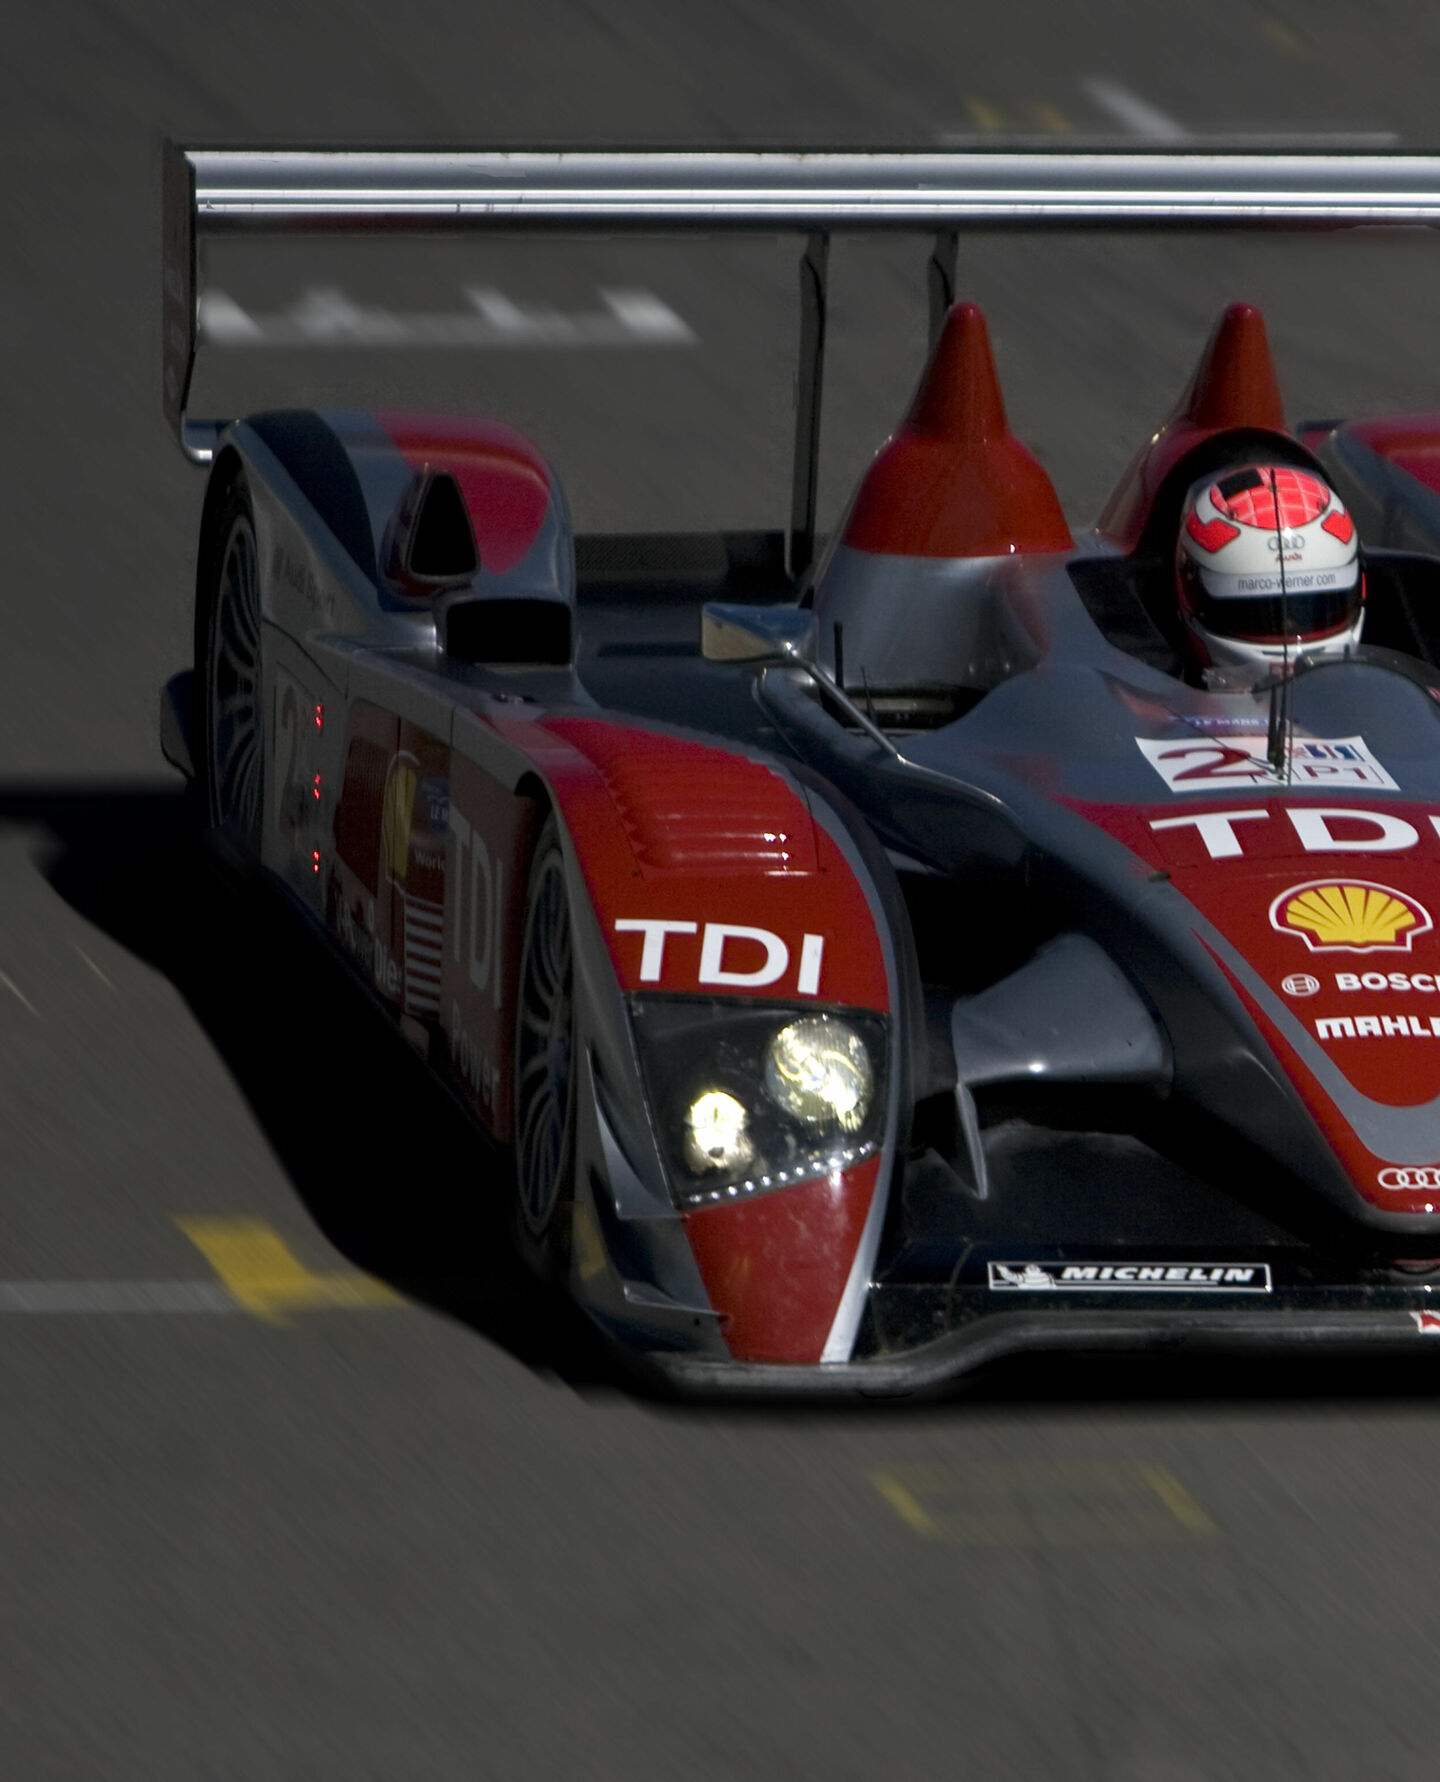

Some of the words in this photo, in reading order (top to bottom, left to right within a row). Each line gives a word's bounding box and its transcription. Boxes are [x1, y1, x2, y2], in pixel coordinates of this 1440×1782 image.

[1275, 552, 1302, 562] Audi
[1238, 573, 1336, 590] marco-werner.com
[1158, 746, 1267, 782] 2
[1303, 764, 1368, 780] P1
[449, 798, 501, 1009] TDI
[614, 918, 824, 995] TDI
[1061, 1266, 1254, 1282] MICHELIN
